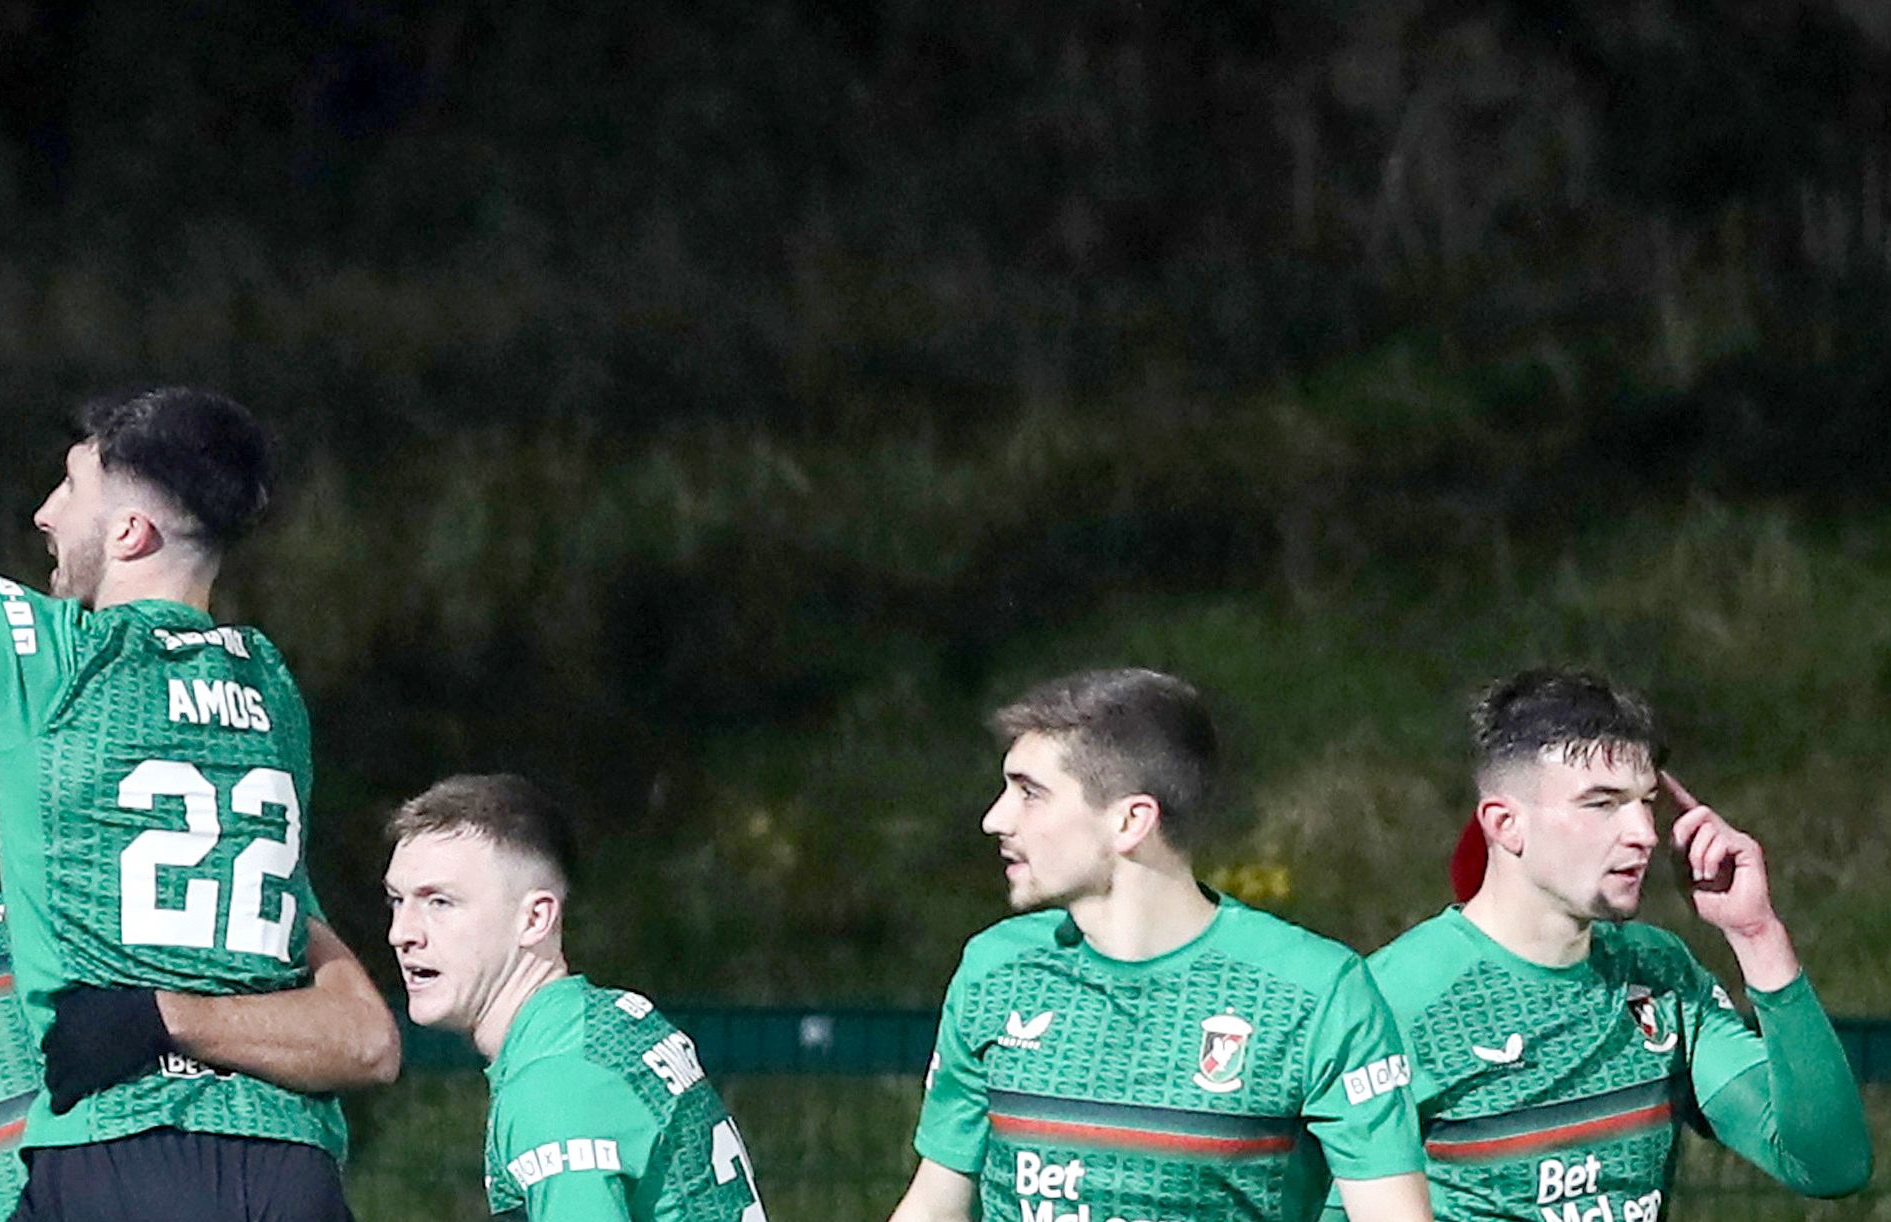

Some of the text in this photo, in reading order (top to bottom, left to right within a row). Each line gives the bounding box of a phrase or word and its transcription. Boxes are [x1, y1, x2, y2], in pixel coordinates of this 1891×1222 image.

[169, 679, 271, 732] AMOS
[118, 760, 301, 962] 22
[1016, 1151, 1085, 1200] Bet
[1536, 1154, 1601, 1204] Bet
